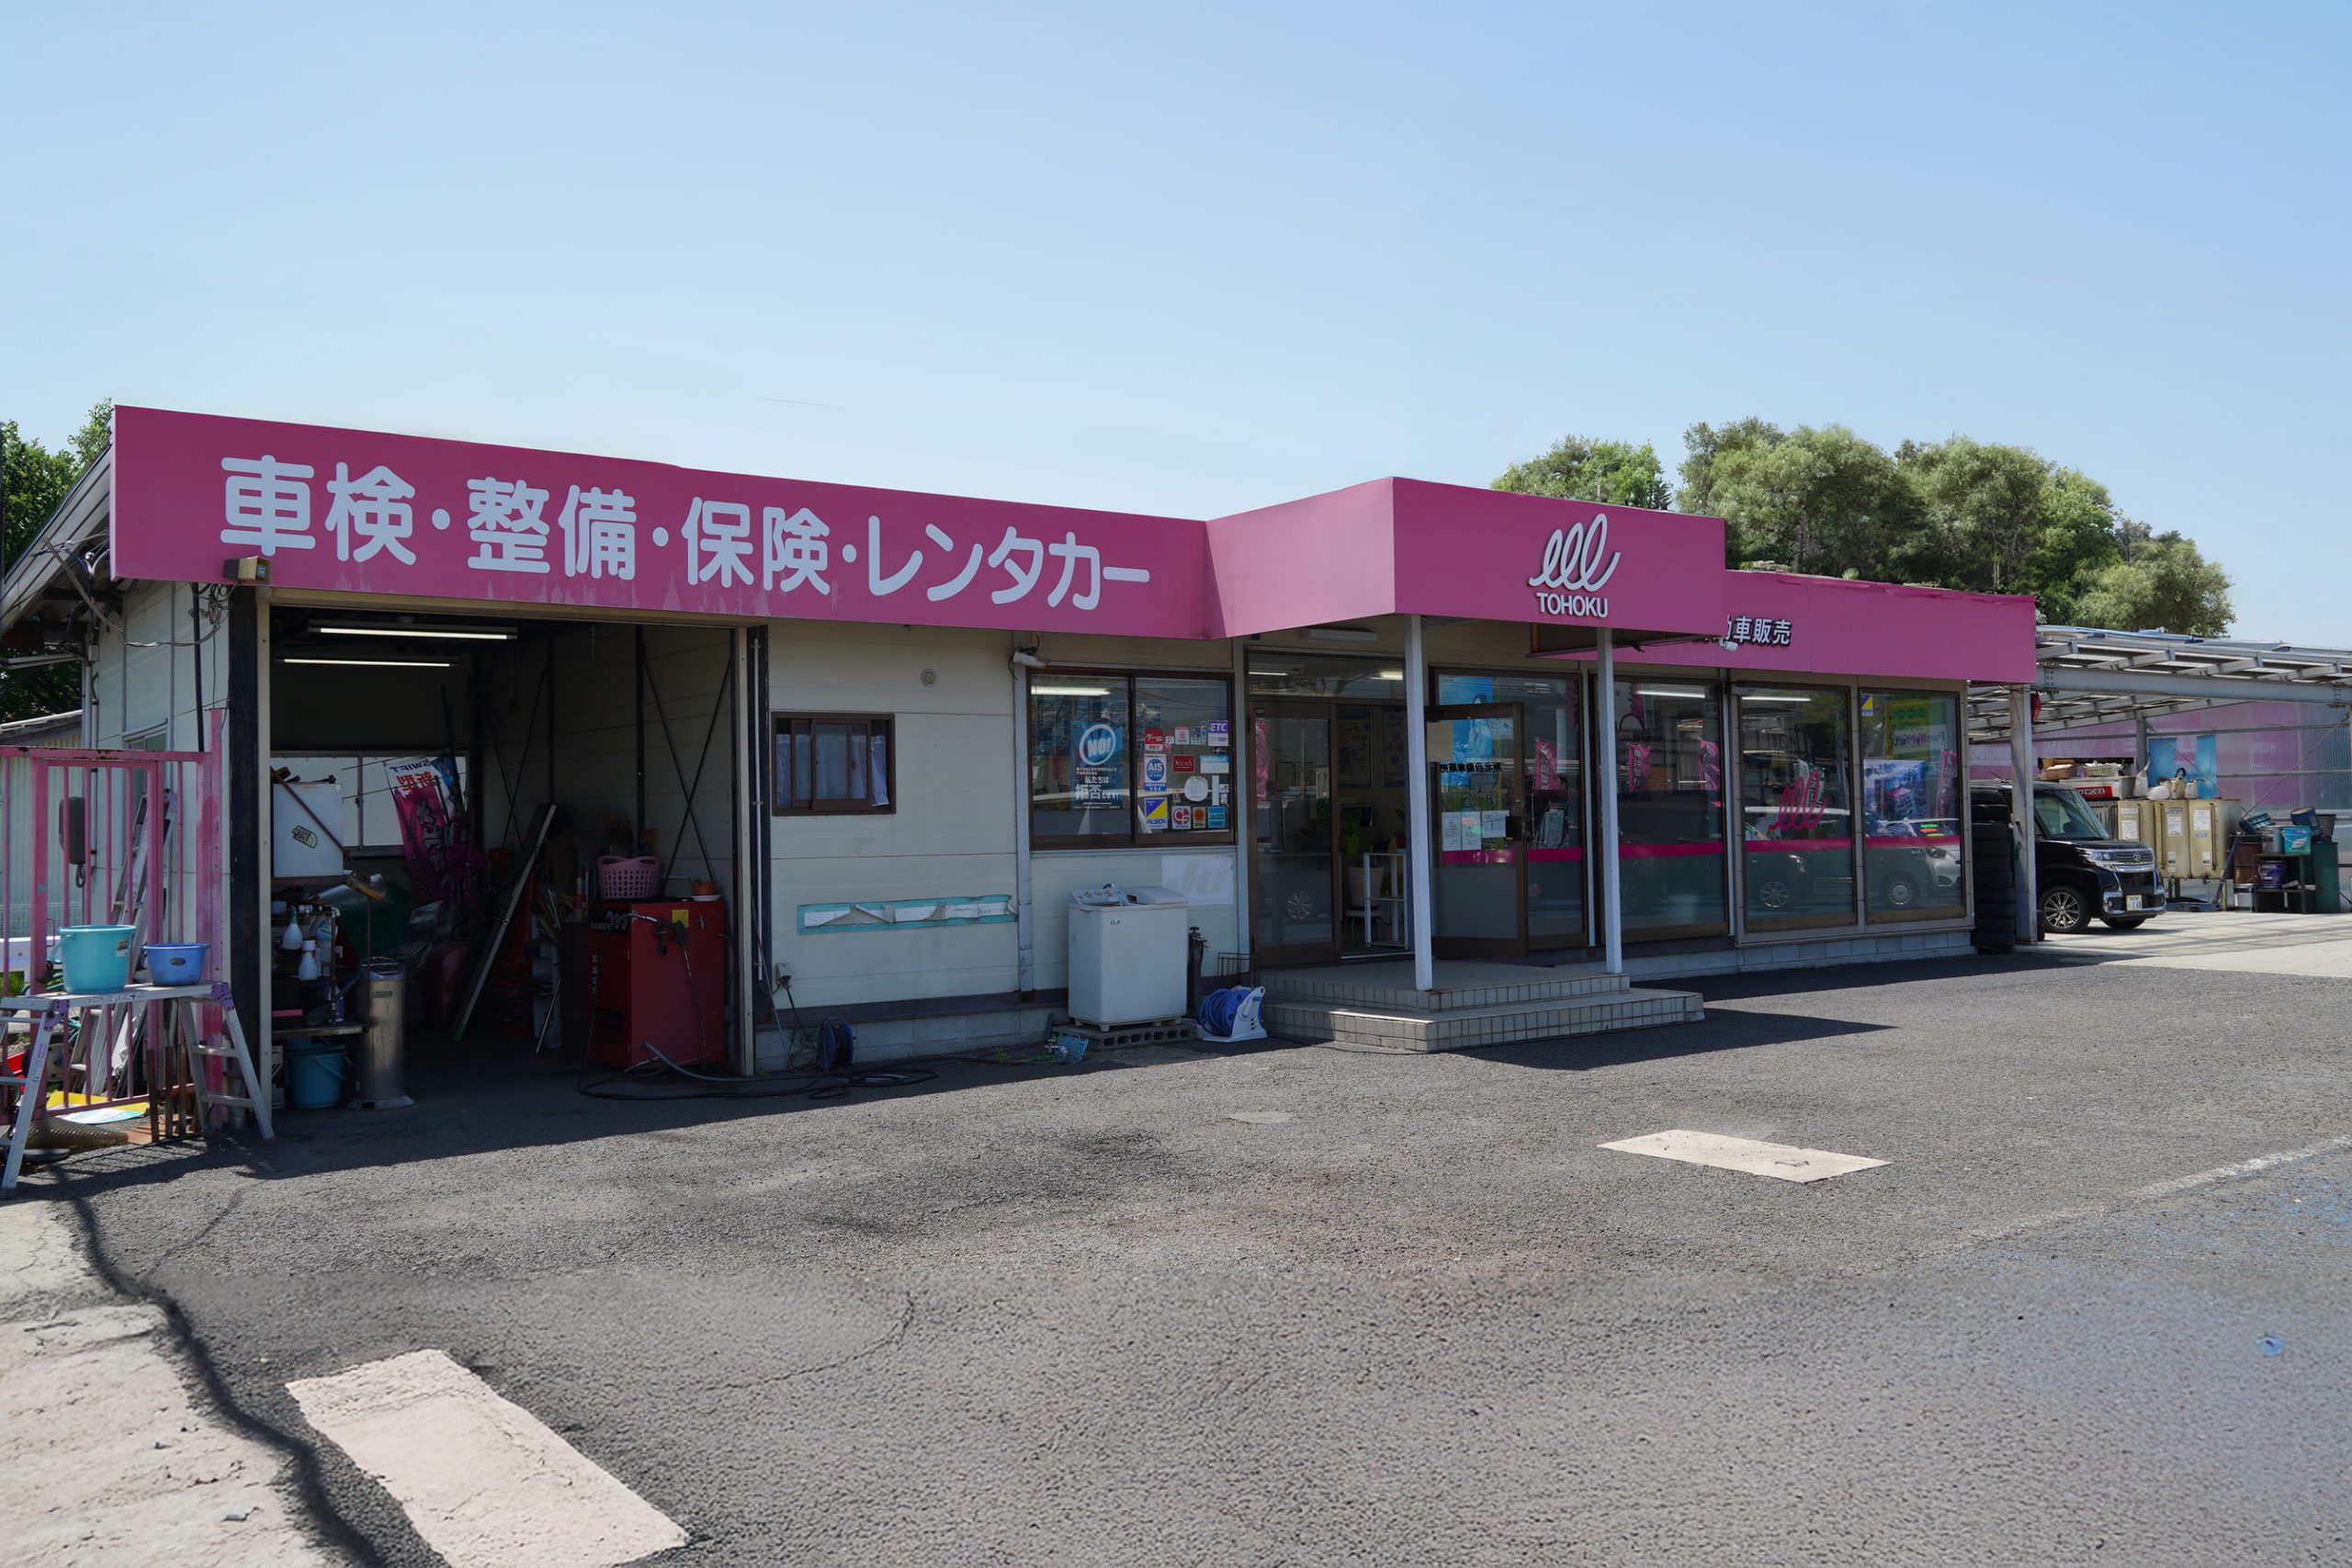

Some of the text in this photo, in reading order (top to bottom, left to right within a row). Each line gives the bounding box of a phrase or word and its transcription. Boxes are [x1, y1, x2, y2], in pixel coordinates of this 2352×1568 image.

[220, 455, 1150, 611] 車検・整備・保険・レンタカー
[1536, 592, 1609, 618] TOHOKU
[1725, 615, 1792, 645] 車販売
[1210, 723, 1227, 732] ETC
[1087, 737, 1112, 757] NO!
[1148, 761, 1163, 772] AIS
[1084, 775, 1110, 784] 私たちは
